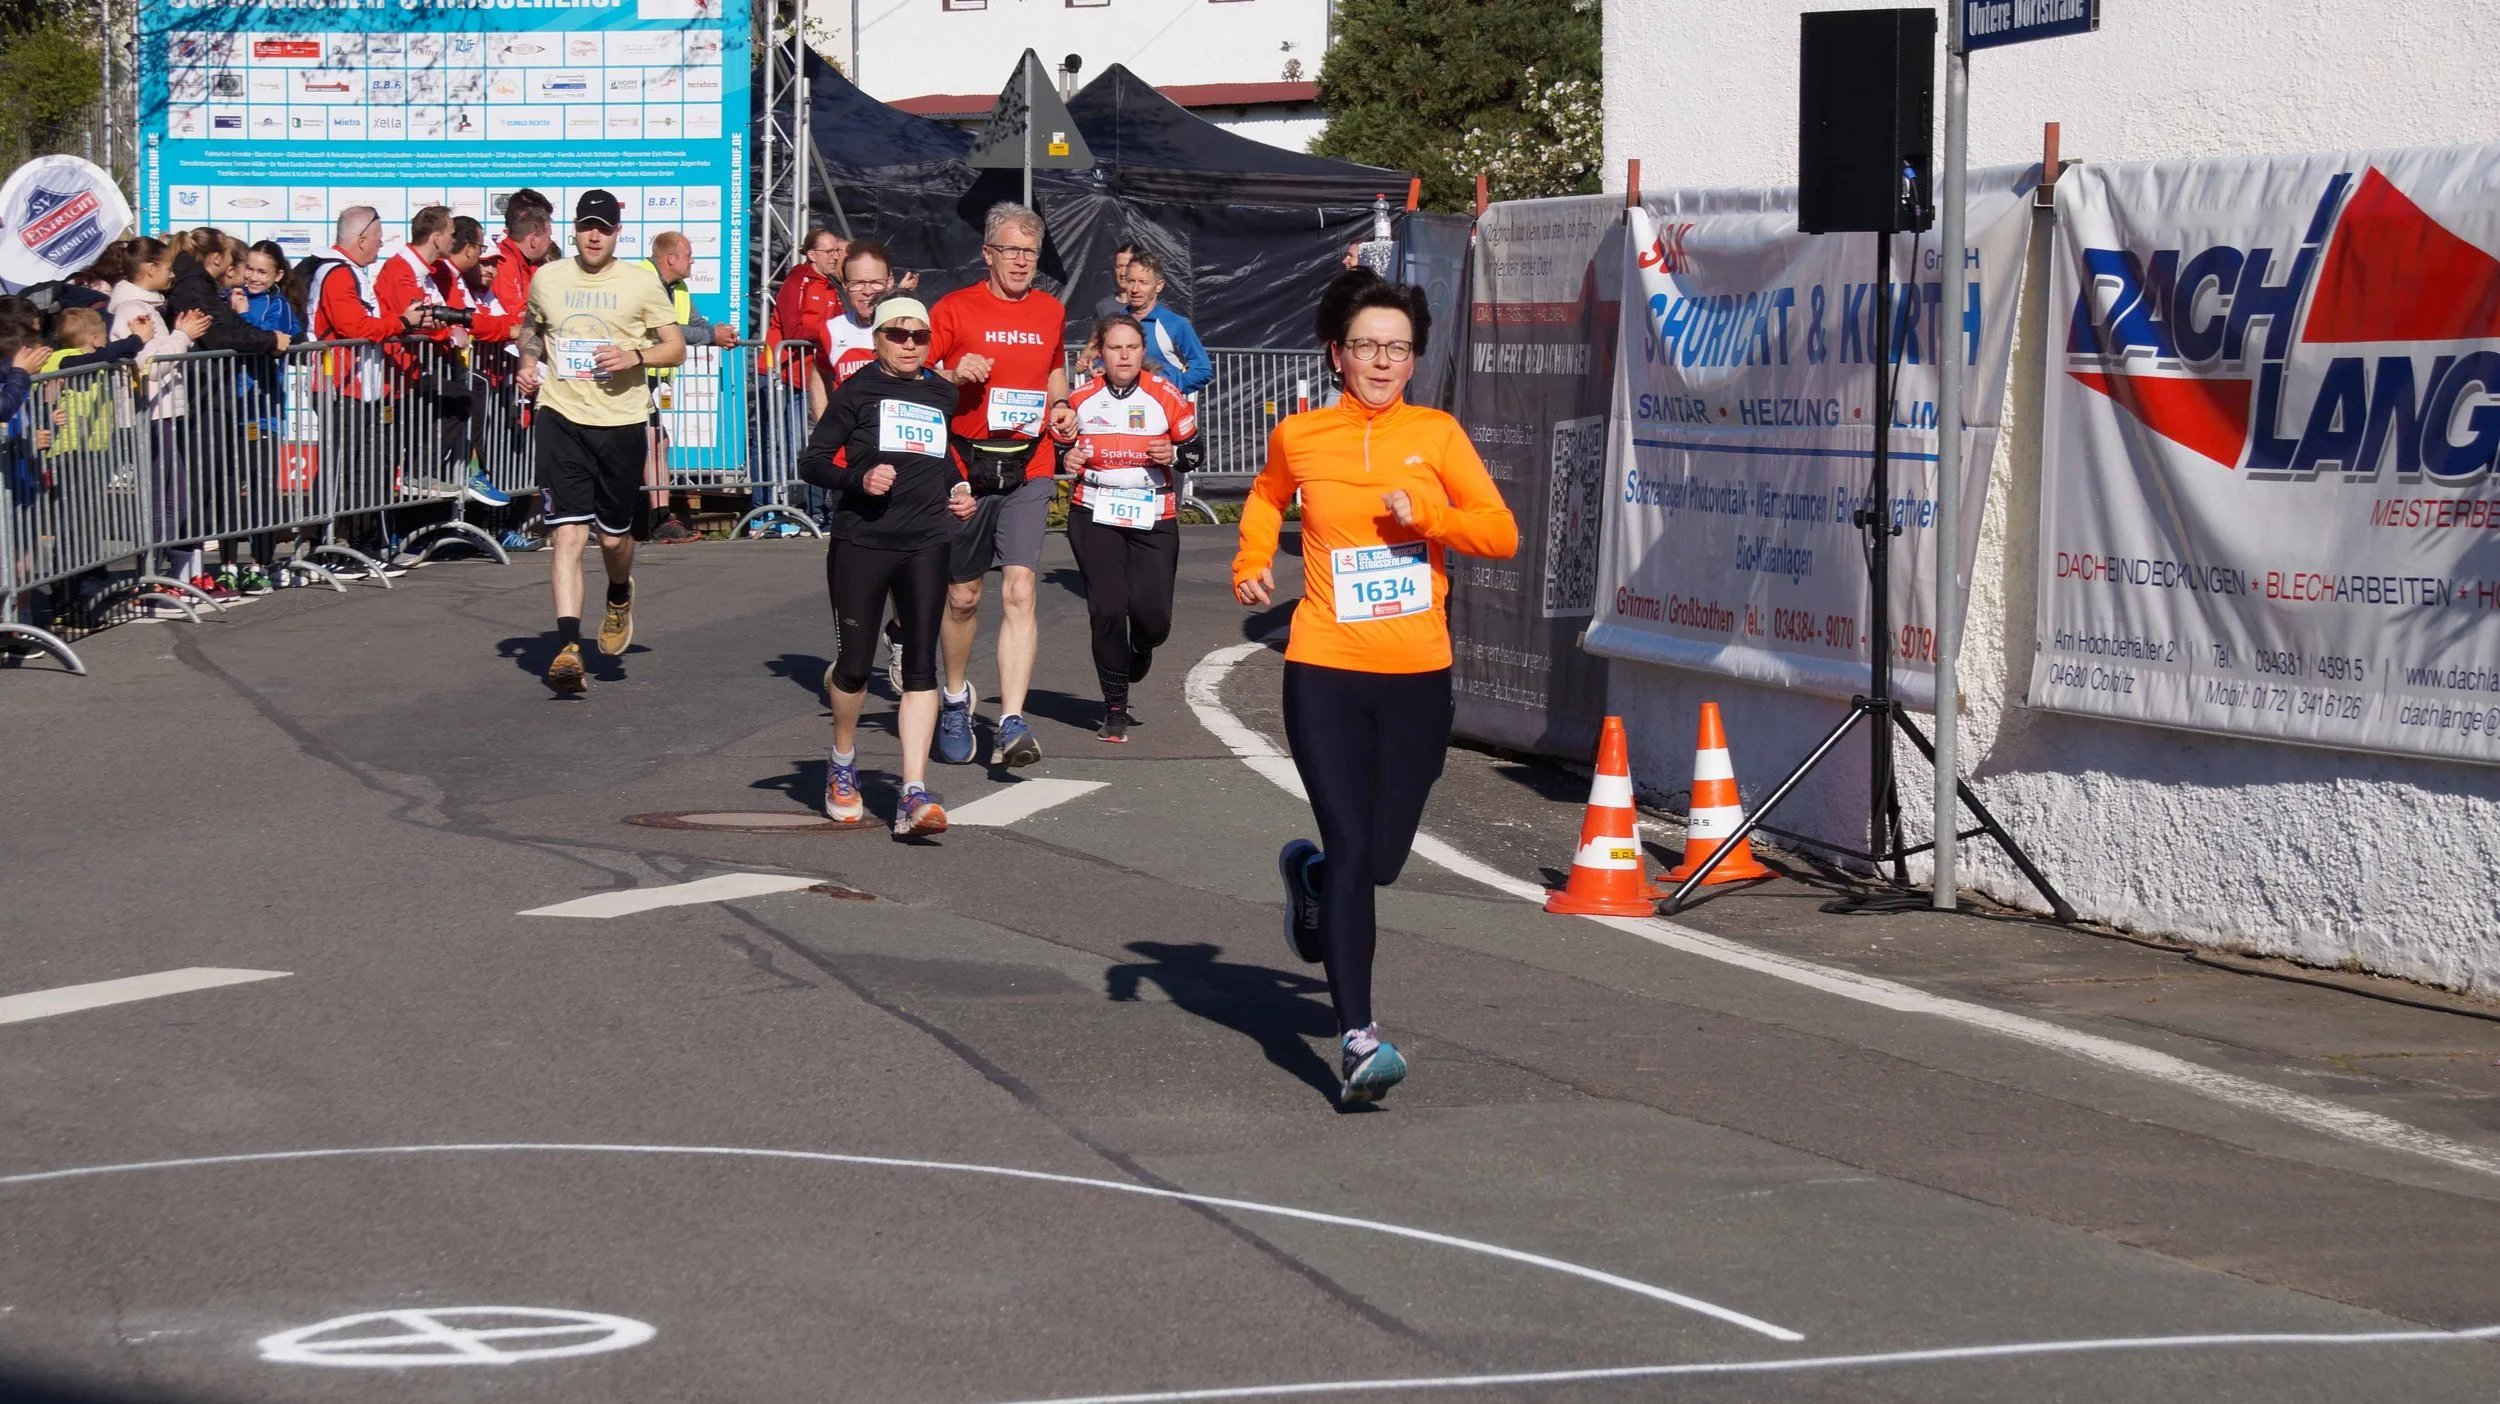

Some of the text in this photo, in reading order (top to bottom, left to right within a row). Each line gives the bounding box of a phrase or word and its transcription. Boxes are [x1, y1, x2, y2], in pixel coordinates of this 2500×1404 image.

[1968, 0, 2010, 36] Untere
[372, 80, 402, 90] B.B.F.
[32, 194, 52, 214] SV
[648, 198, 678, 206] B.B.F.
[26, 197, 95, 243] EINTRACHT
[48, 226, 98, 260] SERMUTH
[564, 289, 619, 310] NIRVANA
[2065, 246, 2322, 364] DACH
[985, 330, 1044, 346] HENSEL
[1808, 284, 1827, 366] &
[566, 357, 593, 370] 164
[1638, 393, 1967, 431] SANITÄR HEIZUNG LIM
[2245, 351, 2500, 476] LANG
[896, 424, 934, 443] 1619
[289, 456, 307, 480] 2
[1100, 449, 1152, 460] Sparkas
[1108, 502, 1142, 519] 1611
[1358, 546, 1423, 561] 55. SCHÖNBACHER
[1359, 556, 1414, 570] STRASSENLAUF
[1352, 576, 1416, 603] 1634
[2056, 552, 2247, 596] DACHEINDECKUNGEN
[2266, 571, 2452, 607] BLECHARBEITEN
[1616, 586, 1660, 620] Grimma
[1668, 594, 1734, 633] Großbothen
[1774, 607, 1815, 645] 034384
[1826, 614, 1853, 650] 9070
[2053, 628, 2176, 662] Am Hochbehälter 2
[2213, 644, 2364, 682] Tel. 034381 45915
[2050, 664, 2136, 694] 04680 Colditz
[2205, 680, 2249, 708] Mobil:
[2252, 686, 2288, 712] 0172
[2298, 692, 2363, 720] 3416126
